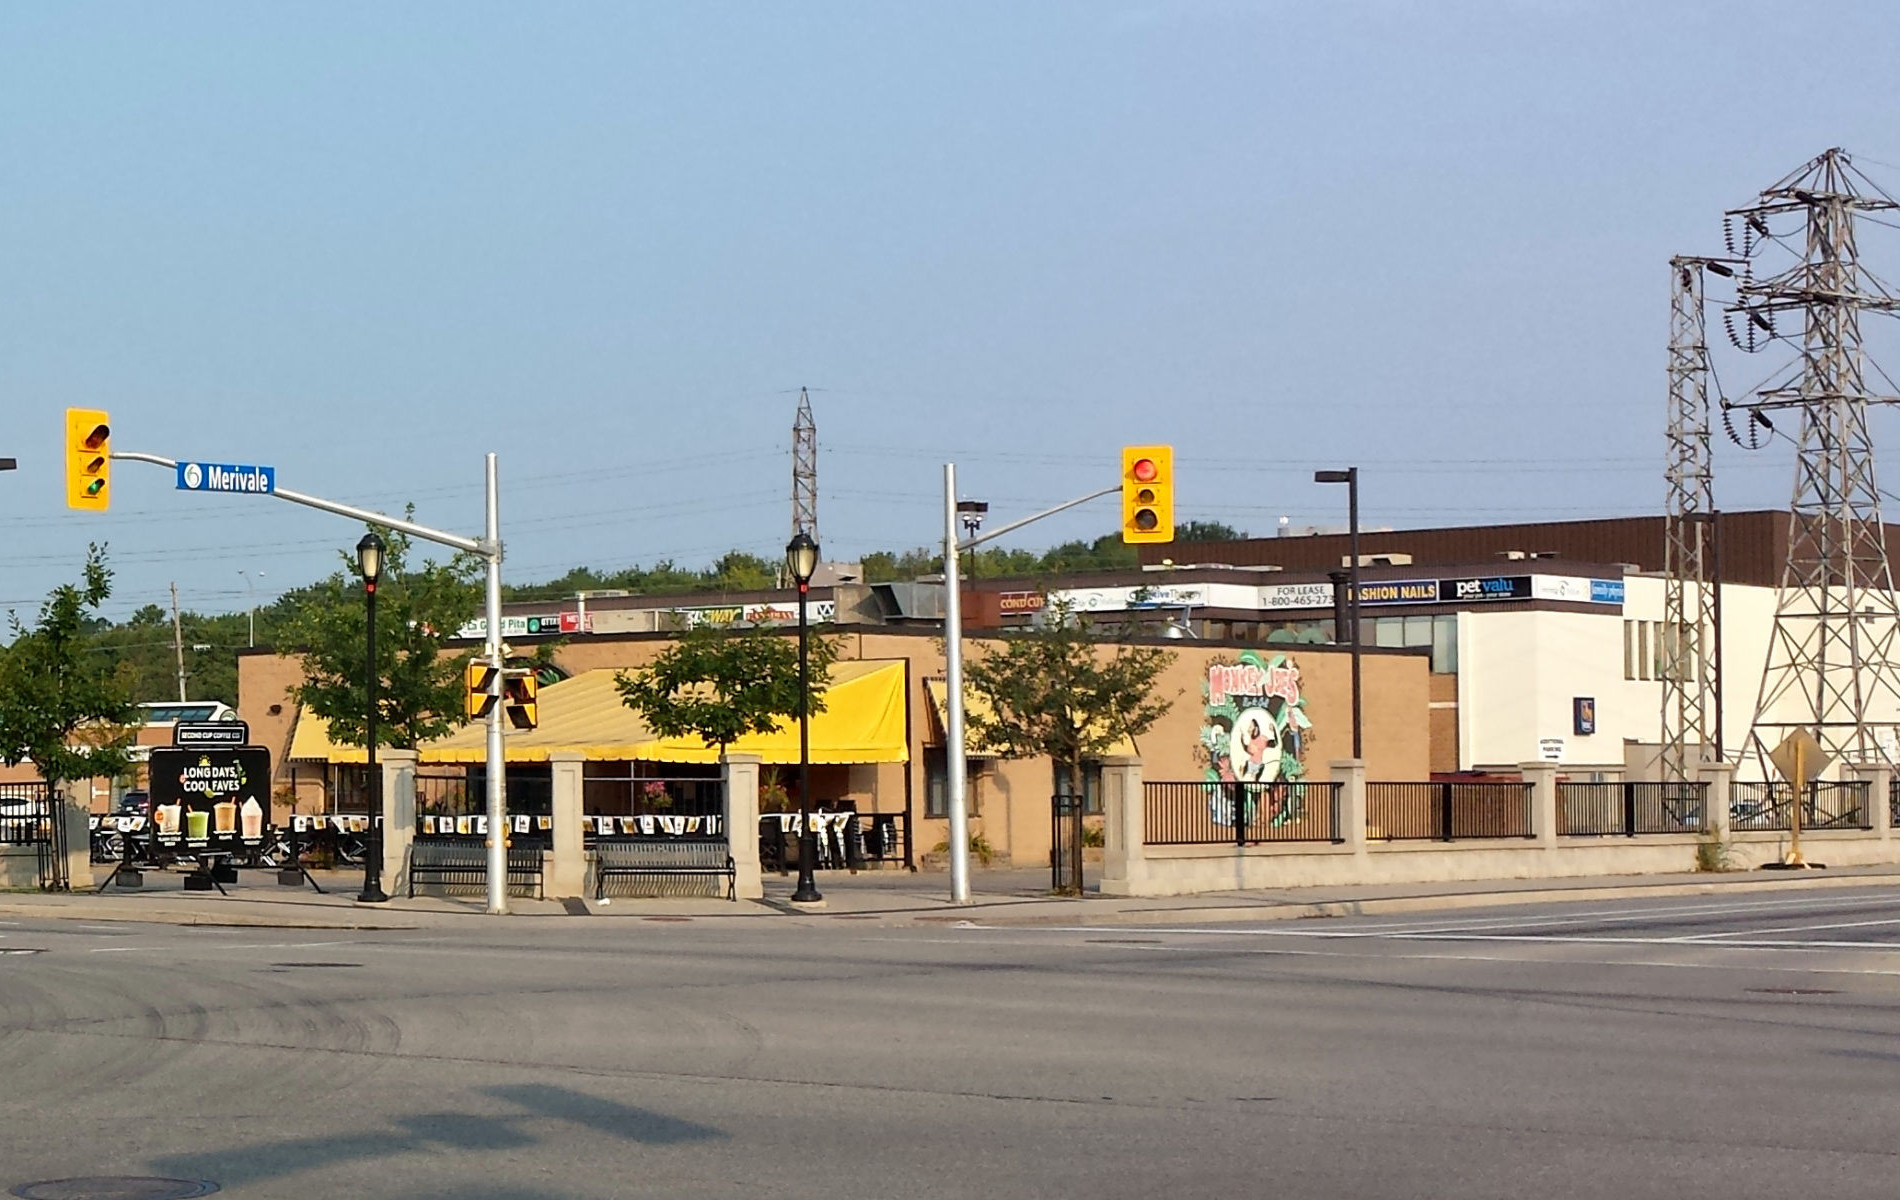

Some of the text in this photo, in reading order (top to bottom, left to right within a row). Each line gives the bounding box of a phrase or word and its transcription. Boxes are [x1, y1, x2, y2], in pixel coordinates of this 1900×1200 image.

[208, 465, 269, 492] Merivale
[1277, 585, 1325, 596] FOR LEASE
[1401, 584, 1435, 599] NAILS
[1455, 576, 1514, 598] pet valu
[1263, 595, 1335, 606] 1-800-465-273
[508, 618, 526, 629] Pita
[1209, 663, 1265, 707] MONKEY
[183, 766, 238, 779] LONG DAYS,
[183, 779, 240, 792] COOL FAVES
